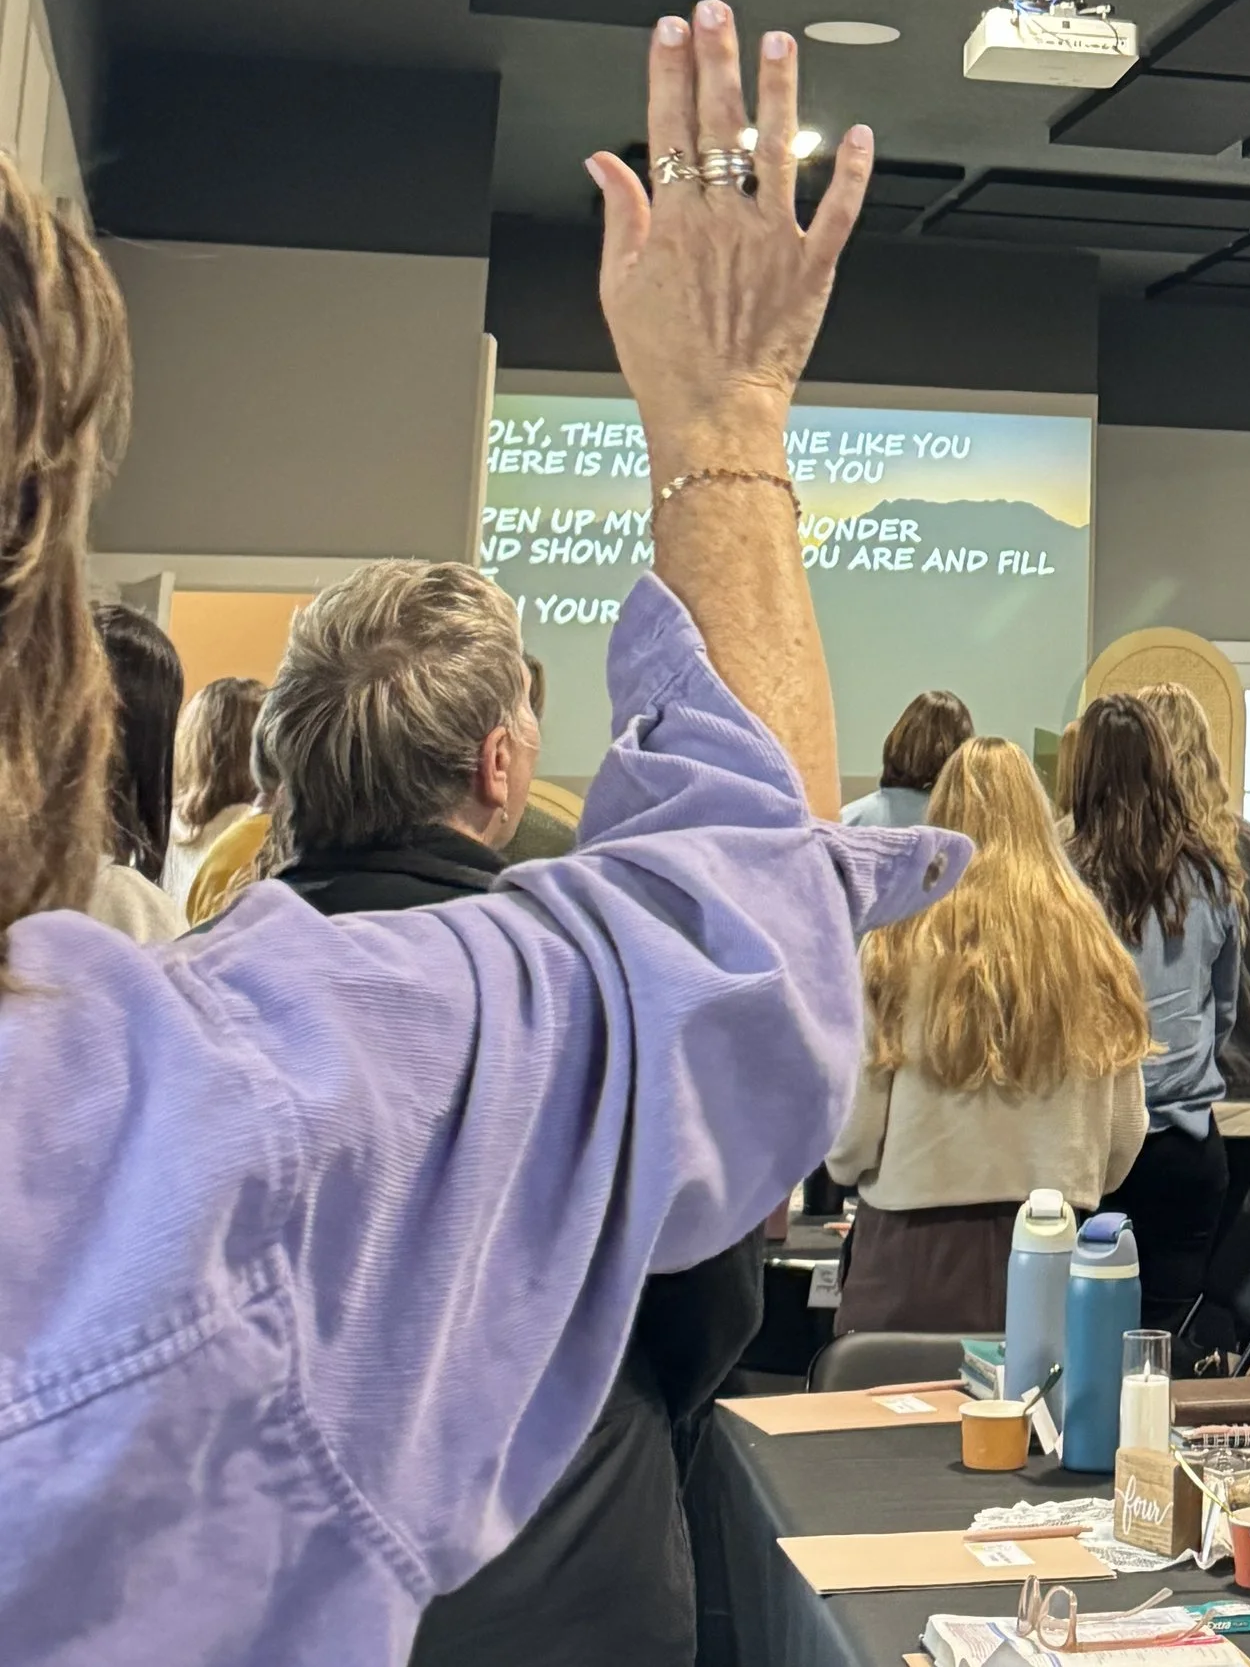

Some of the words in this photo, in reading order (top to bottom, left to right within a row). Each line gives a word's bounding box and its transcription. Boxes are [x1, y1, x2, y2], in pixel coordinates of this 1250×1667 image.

[487, 417, 552, 448] OLY,
[560, 420, 648, 448] THER
[783, 428, 831, 455] NE
[839, 432, 905, 457] LIKE
[912, 432, 972, 459] YOU
[487, 447, 567, 475] HERE
[574, 450, 603, 477] IS
[611, 451, 651, 478] NO
[824, 457, 885, 484] YOU
[481, 506, 542, 534] PEN
[551, 508, 597, 535] UP
[603, 508, 653, 537] MY
[479, 535, 522, 564] ND
[528, 536, 624, 566] SHOW
[630, 540, 655, 566] M
[801, 544, 841, 570] OU
[847, 545, 916, 572] ARE
[921, 547, 989, 574] AND
[998, 550, 1055, 576] FILL
[535, 594, 621, 625] YOUR
[1115, 1474, 1174, 1535] four
